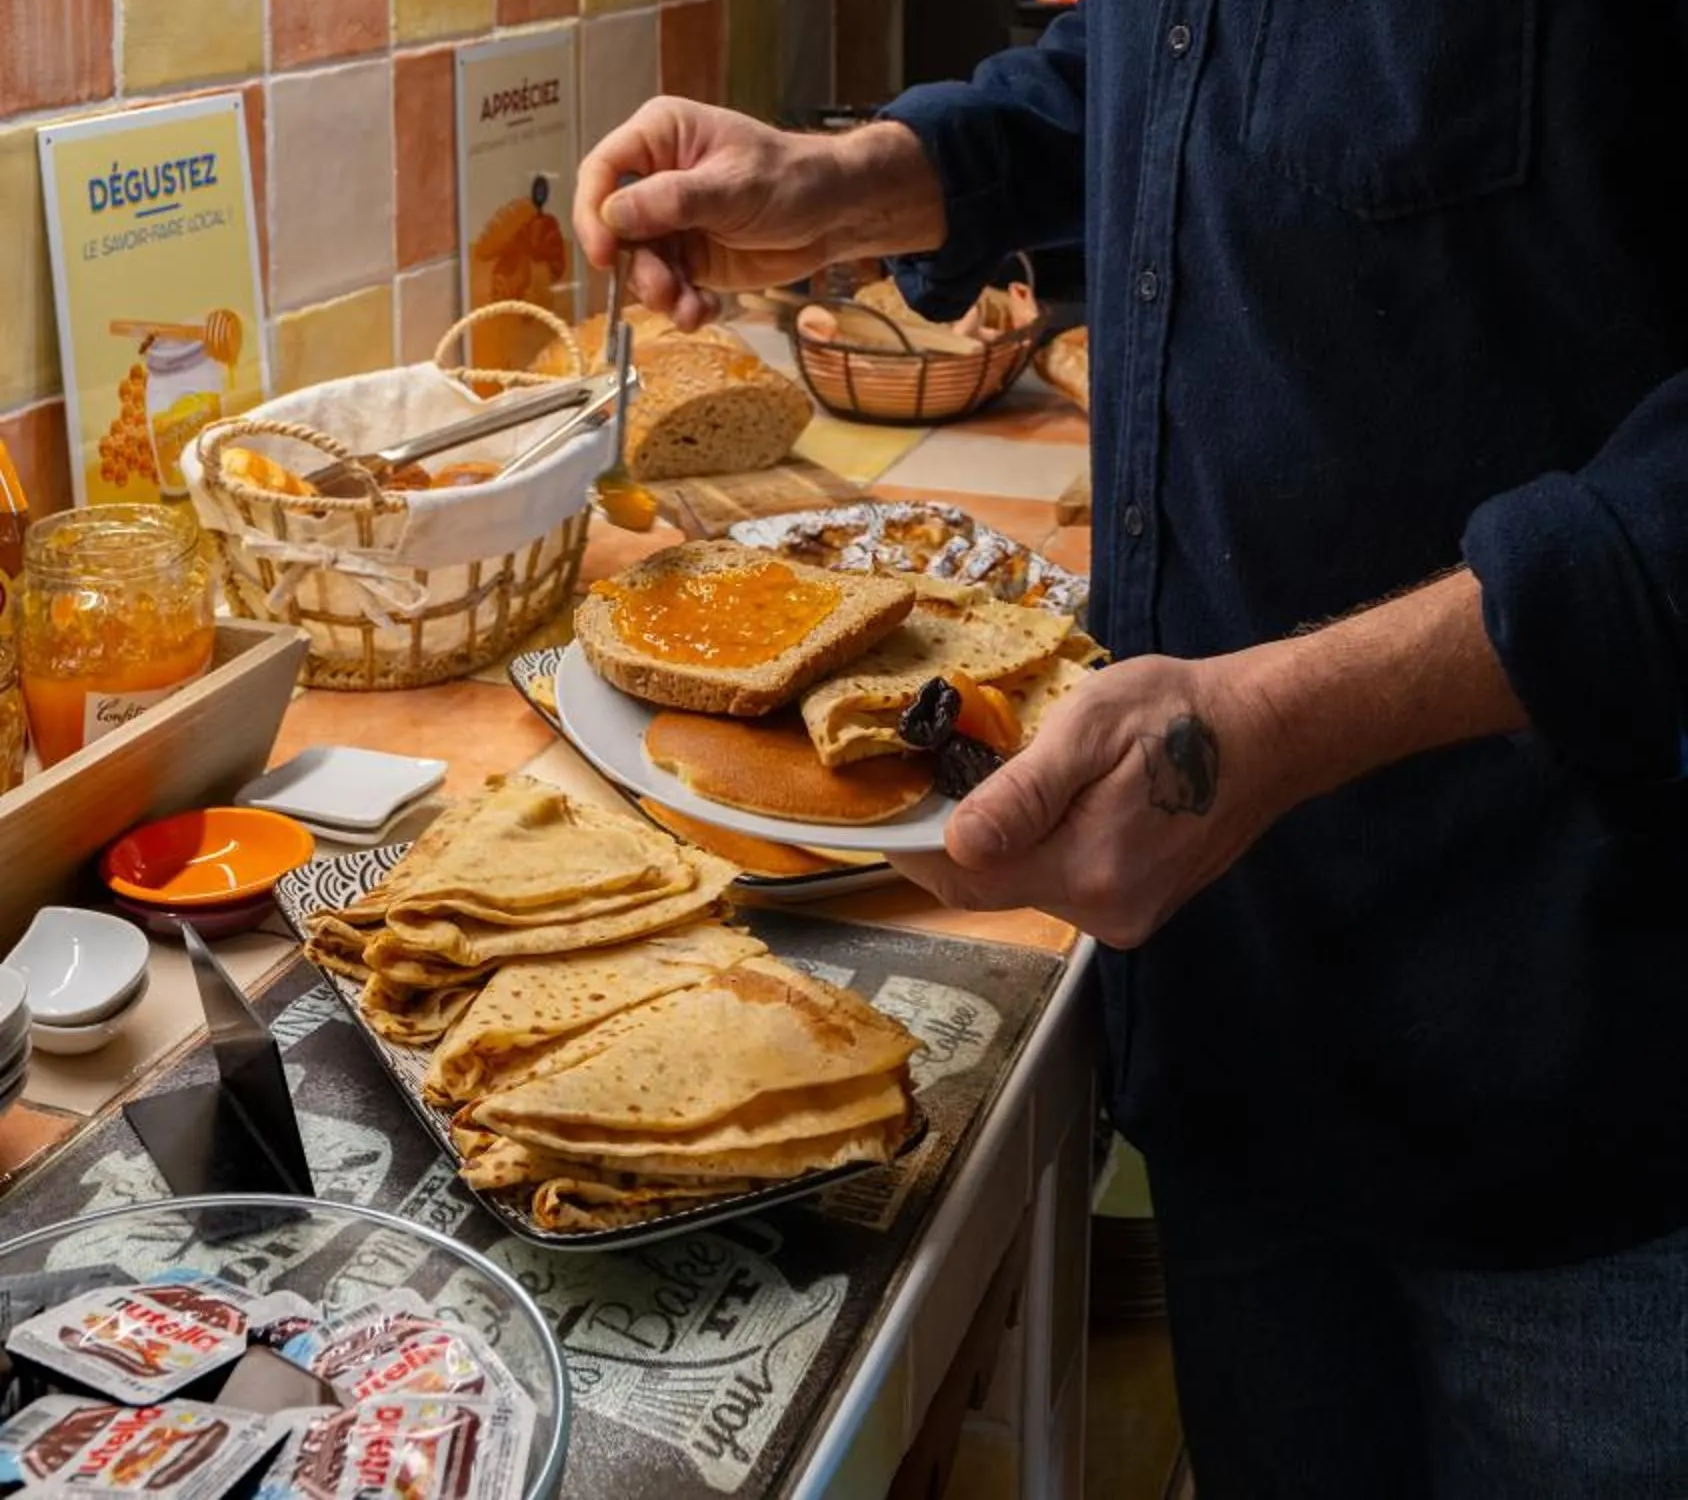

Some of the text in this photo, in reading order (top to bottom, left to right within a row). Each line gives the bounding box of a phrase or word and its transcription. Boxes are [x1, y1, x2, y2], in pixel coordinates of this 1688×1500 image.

[479, 76, 560, 122] APPRÉCIEZ
[88, 153, 217, 214] DÉGUSTEZ
[84, 239, 98, 261] LE
[101, 216, 184, 257] SAVOIR-FAIRE
[105, 1296, 221, 1354] nutella
[587, 1239, 728, 1355] Bake
[355, 1343, 442, 1402] utell
[65, 1403, 165, 1483] nutella
[692, 1372, 774, 1464] you
[353, 1406, 404, 1500] nutella
